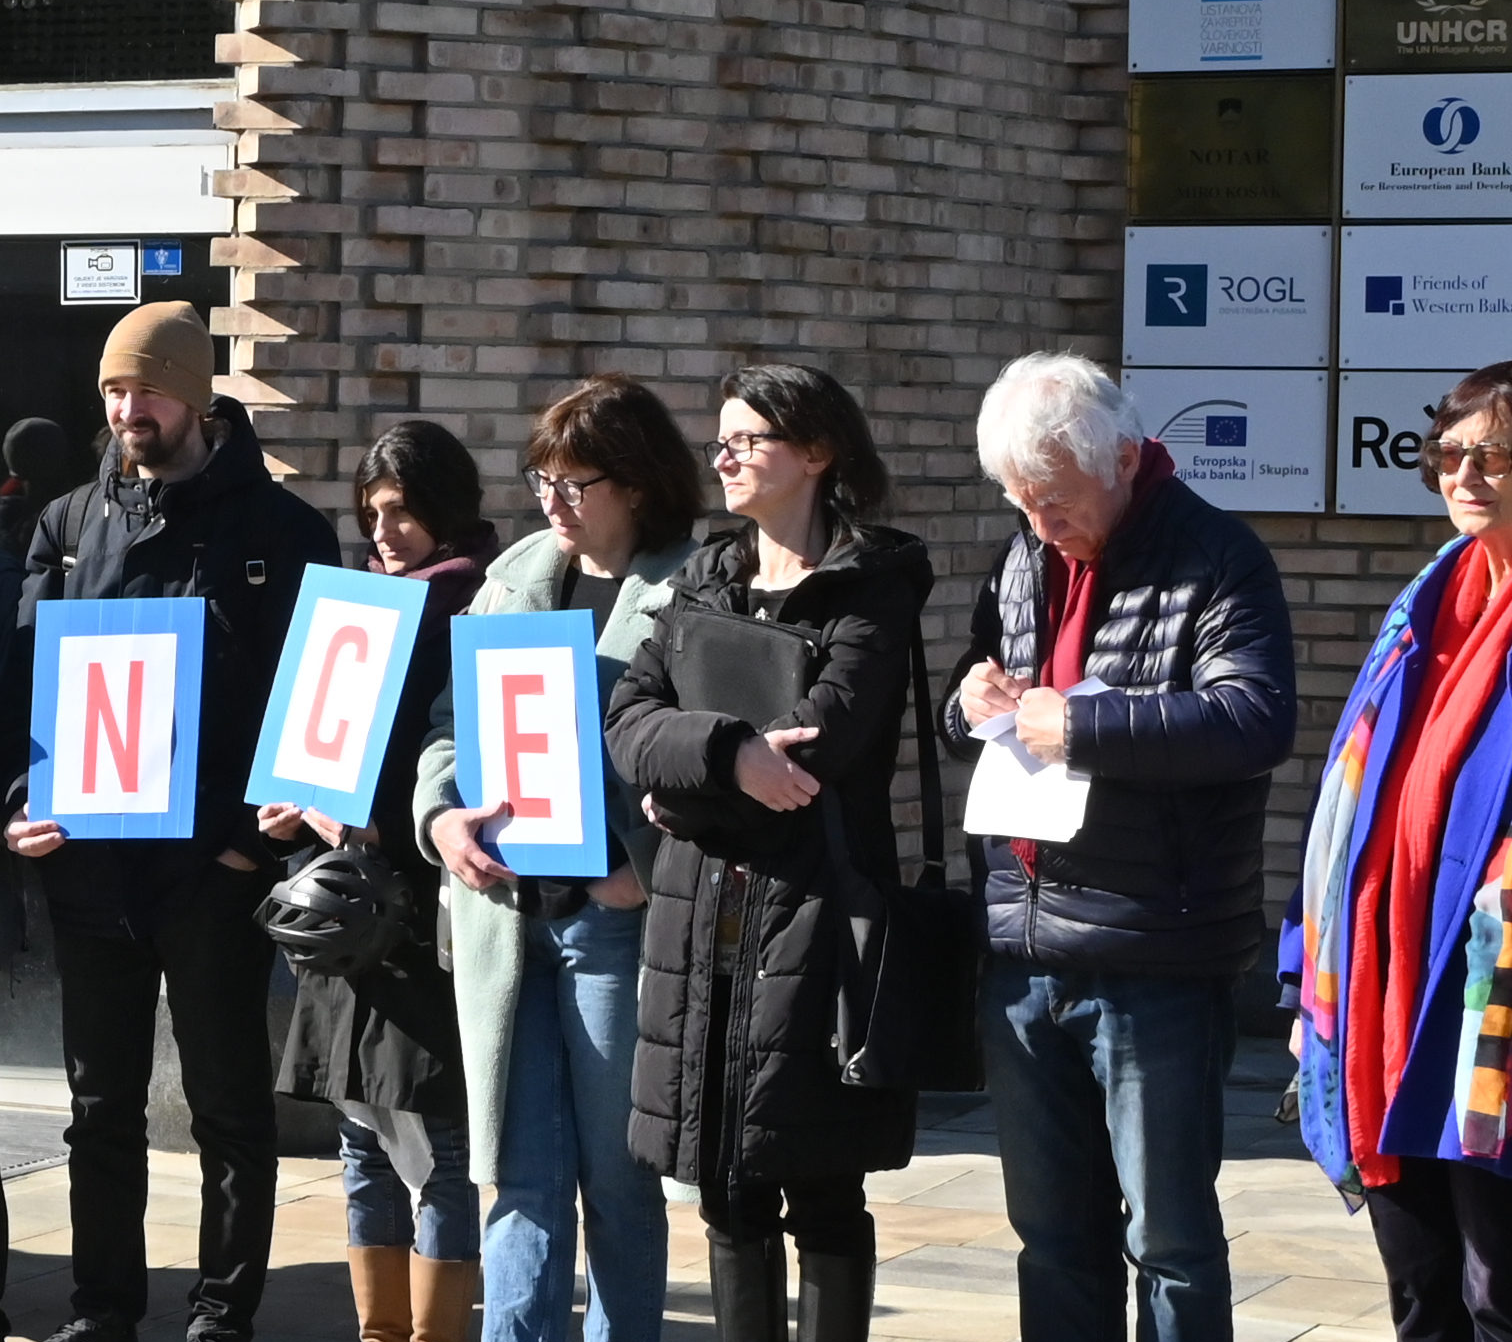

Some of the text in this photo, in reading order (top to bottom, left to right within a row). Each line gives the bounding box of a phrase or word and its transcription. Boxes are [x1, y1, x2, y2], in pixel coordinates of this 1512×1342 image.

[1200, 3, 1263, 16] USTANOVA
[1396, 19, 1508, 44] UNHCR
[1200, 41, 1263, 54] VARNOSTI
[1397, 45, 1508, 55] The UN Refugee Agency
[1189, 148, 1271, 165] NOTAR
[1390, 162, 1512, 180] European Bank
[1360, 181, 1375, 191] for
[1378, 181, 1452, 191] Reconstruction
[1455, 181, 1473, 191] and
[1218, 276, 1305, 303] ROGL
[1412, 275, 1488, 291] Friends of
[1411, 298, 1474, 314] Western
[1192, 455, 1247, 469] Evropska
[1210, 469, 1246, 481] banka
[1259, 464, 1309, 477] Skupina
[81, 660, 145, 794] N
[500, 674, 553, 819] E
